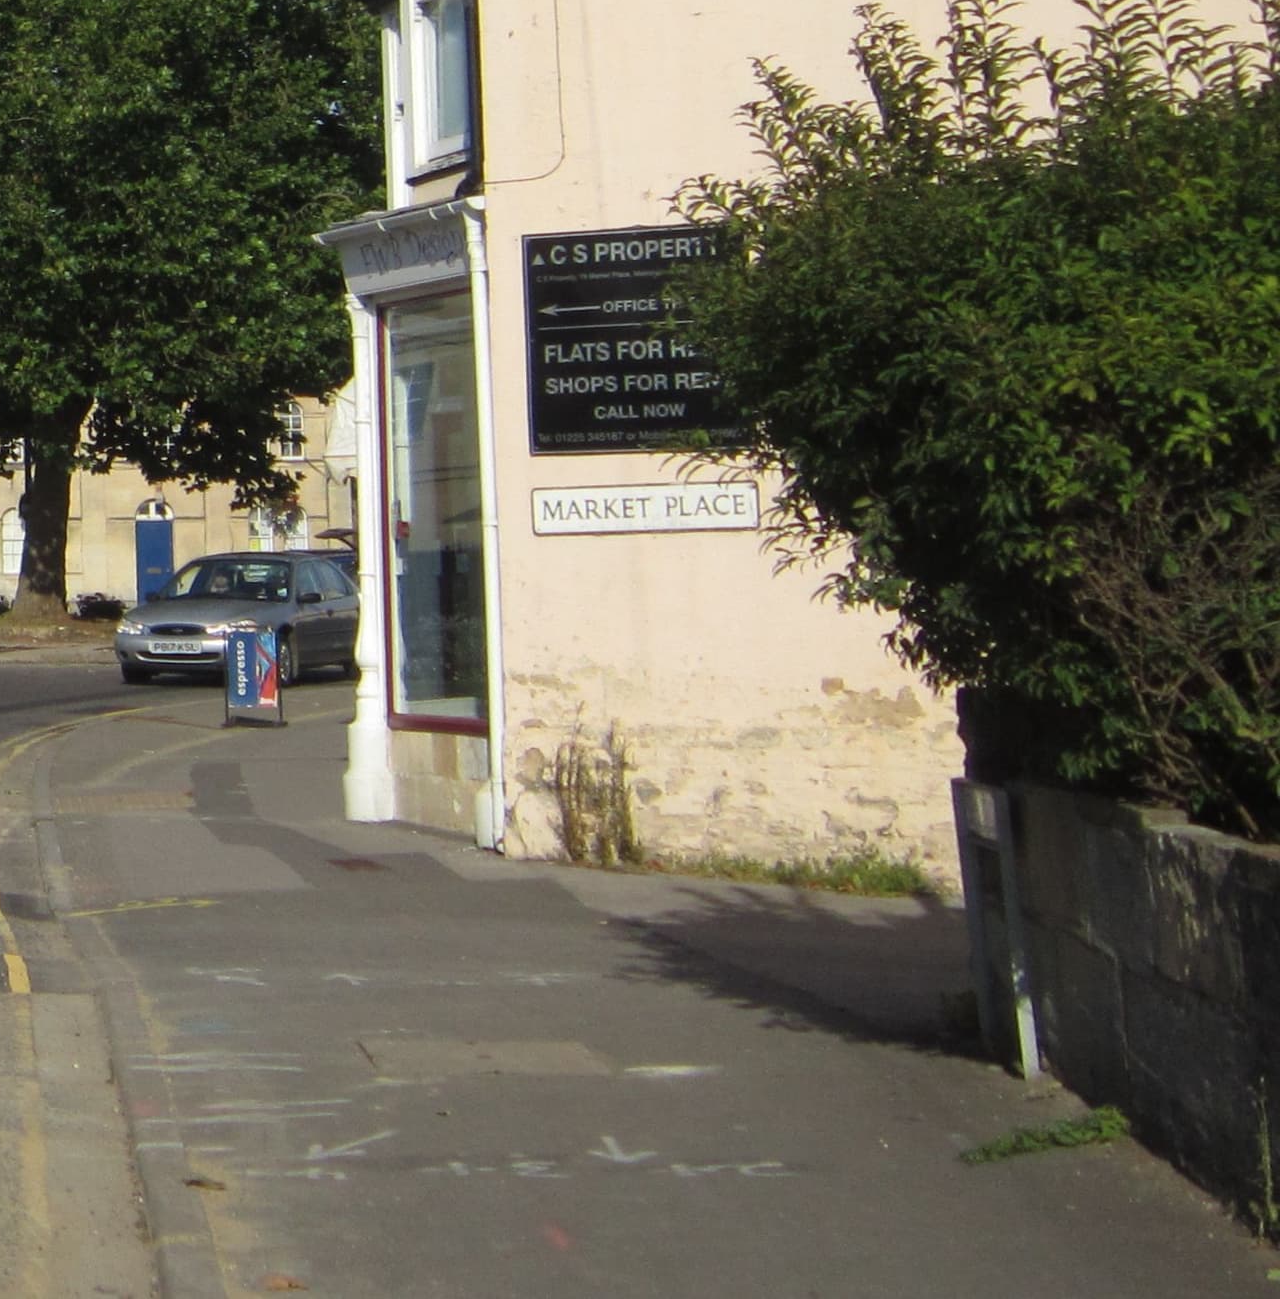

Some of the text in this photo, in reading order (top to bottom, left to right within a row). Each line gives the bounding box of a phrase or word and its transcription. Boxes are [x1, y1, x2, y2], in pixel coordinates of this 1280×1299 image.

[550, 245, 567, 264] C
[573, 244, 588, 263] S
[602, 299, 658, 313] OFFICE
[544, 343, 610, 364] FLATS
[617, 340, 663, 360] FOR
[545, 372, 720, 394] SHOPS FOR REN
[594, 403, 686, 419] CALL NOW
[543, 495, 746, 521] MARKET PLACE
[236, 640, 248, 696] espresso
